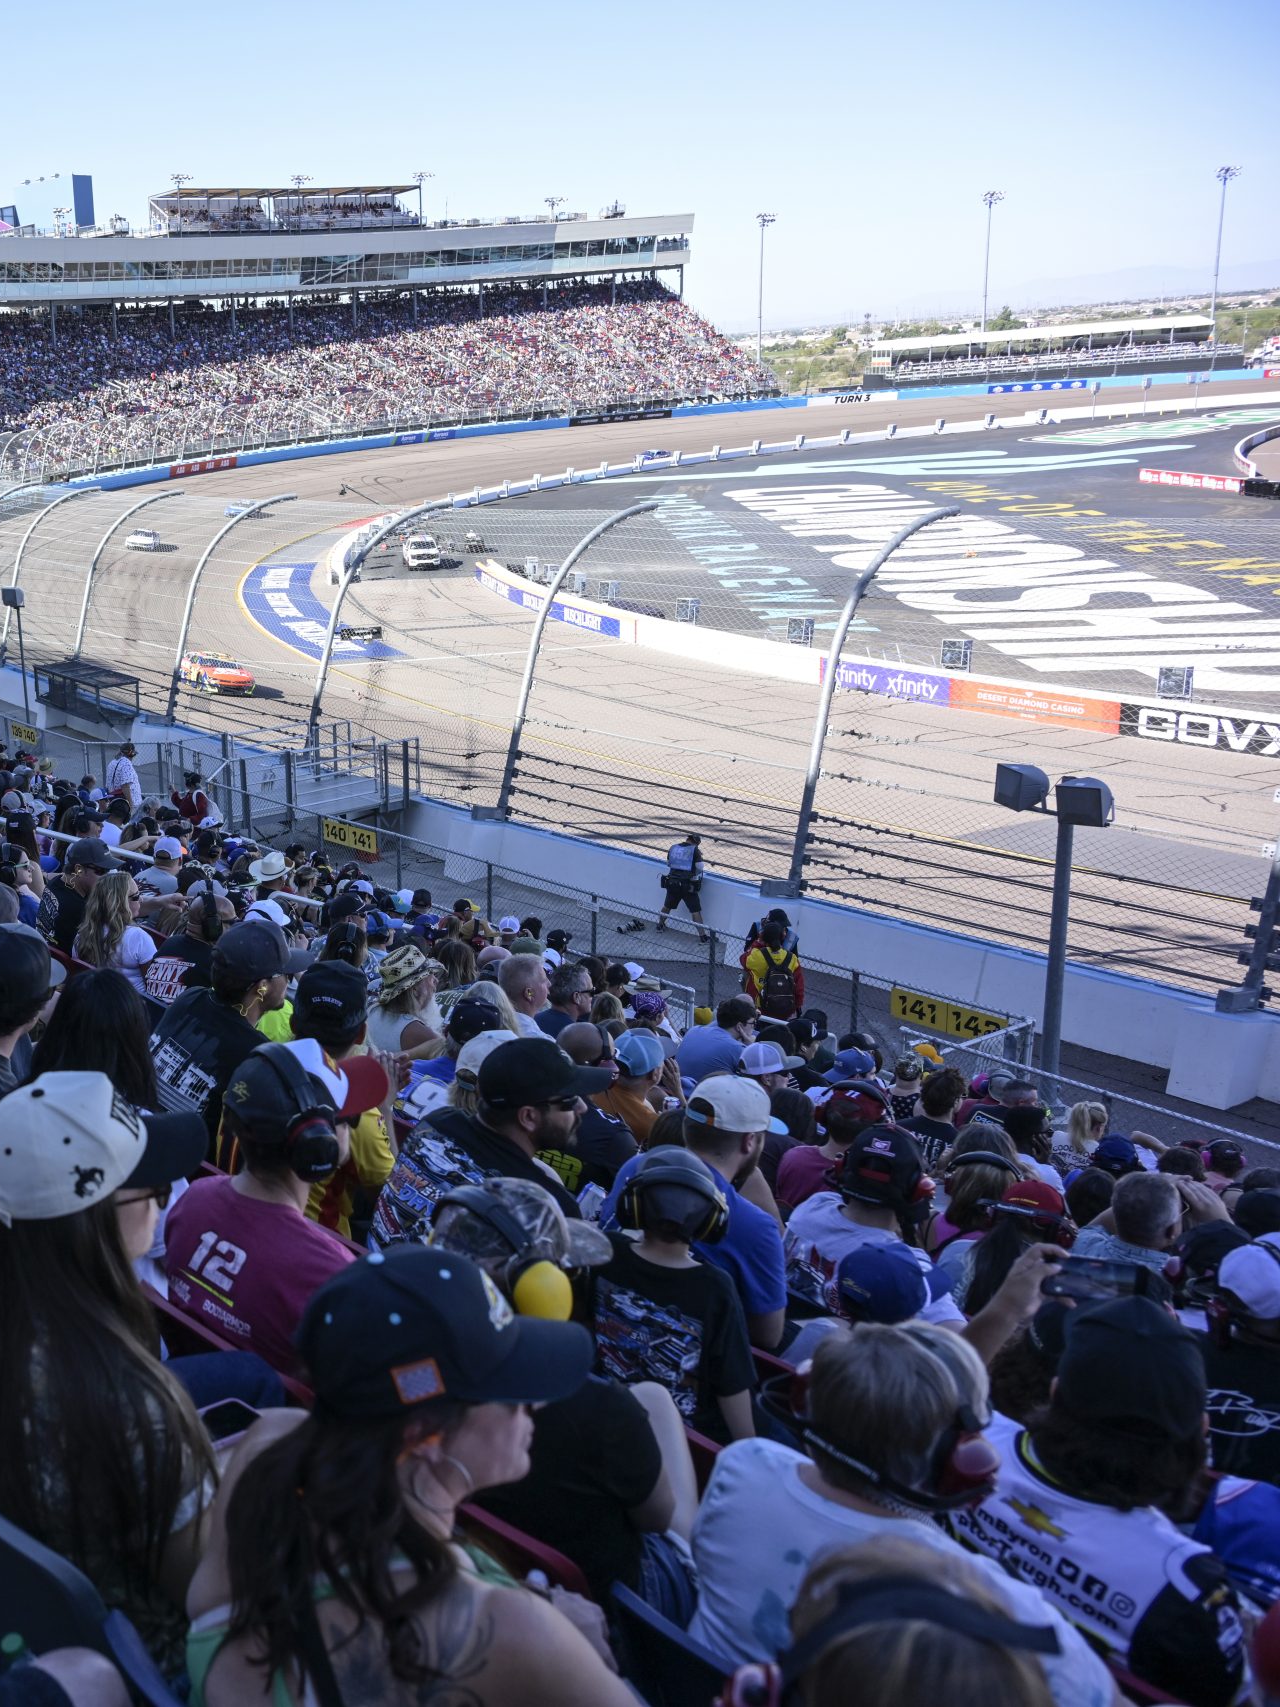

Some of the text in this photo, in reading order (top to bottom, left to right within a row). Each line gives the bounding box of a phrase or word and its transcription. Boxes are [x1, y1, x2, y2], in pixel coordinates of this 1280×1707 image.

[834, 393, 871, 404] TURN 3
[176, 465, 185, 474] ABB
[191, 464, 200, 472] ABB
[206, 462, 215, 470] ABB
[221, 459, 230, 467] ABB
[887, 673, 939, 699] xfinity
[977, 692, 1007, 703] DESERT
[1009, 697, 1049, 710] DIAMOND
[1051, 703, 1085, 715] CASINO
[23, 729, 36, 743] 140
[325, 823, 371, 849] 140 141
[898, 995, 936, 1025] 141
[1052, 1144, 1075, 1152] GOOD
[187, 1231, 248, 1292] 12
[977, 1507, 1053, 1567] mByron
